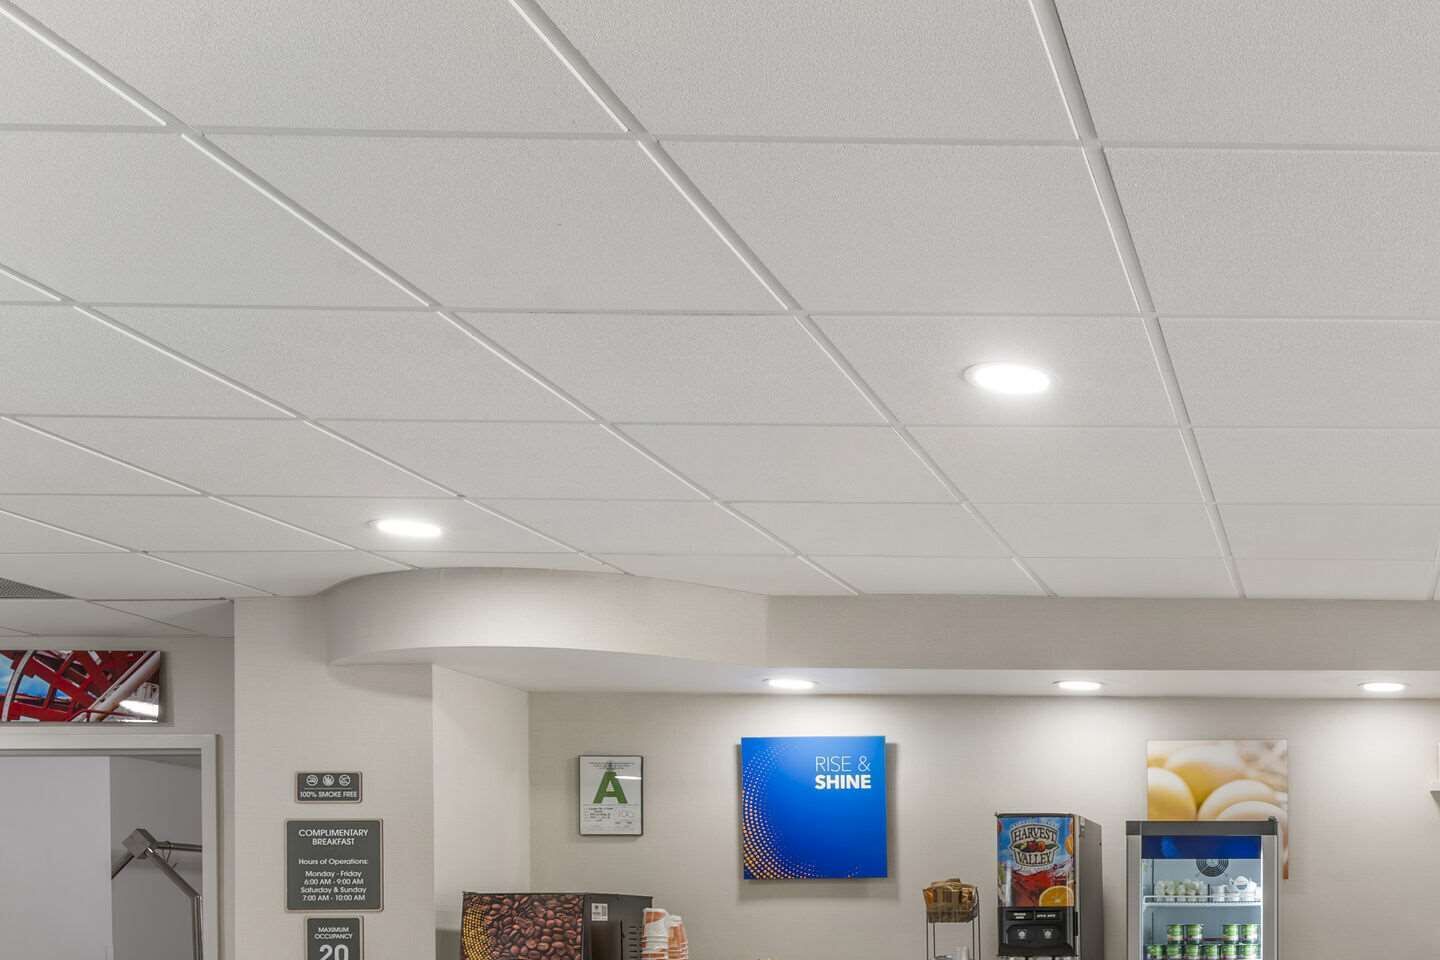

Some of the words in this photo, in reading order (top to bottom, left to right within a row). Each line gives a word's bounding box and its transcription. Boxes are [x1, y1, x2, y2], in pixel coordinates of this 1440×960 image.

[815, 755, 852, 772] RISE
[857, 755, 871, 772] &
[592, 771, 628, 804] A
[815, 774, 872, 790] SHINE
[298, 829, 369, 837] COMPLIMENTARY
[1013, 827, 1057, 842] HARVEST
[312, 838, 355, 846] BREAKFAST
[1016, 851, 1053, 865] VALLEY
[305, 870, 335, 878] Monday
[340, 870, 362, 878] Friday
[300, 886, 332, 894] Saturday
[340, 886, 367, 894] Sunday
